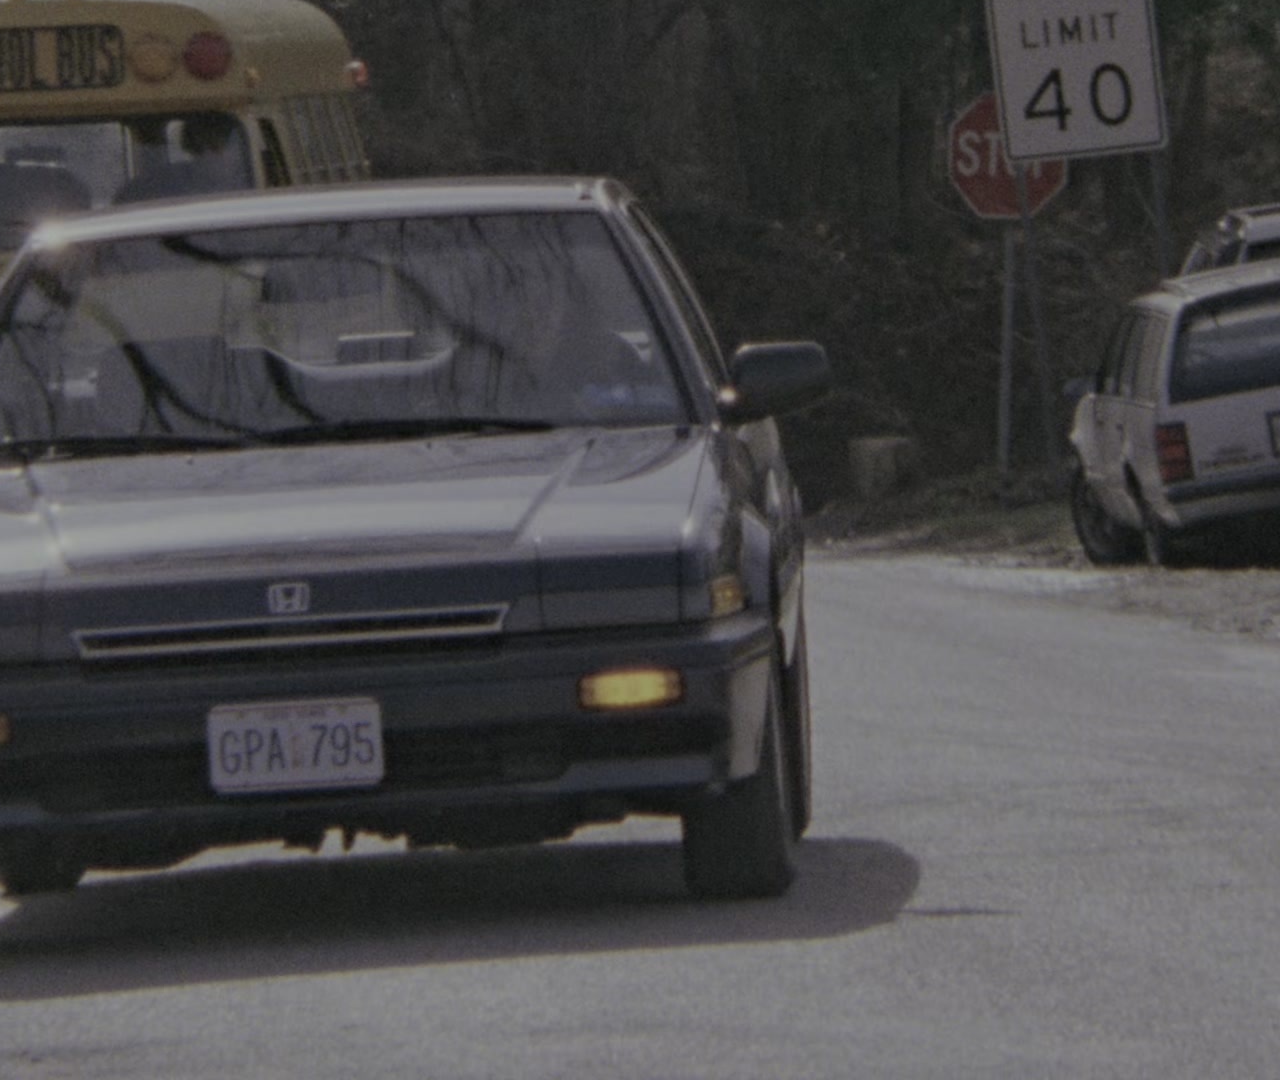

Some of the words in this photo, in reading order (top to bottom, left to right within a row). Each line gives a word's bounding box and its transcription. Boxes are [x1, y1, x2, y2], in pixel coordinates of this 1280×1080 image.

[57, 26, 122, 87] BUS
[1021, 12, 1119, 49] LIMIT
[1024, 63, 1133, 132] 40
[956, 130, 1042, 180] ST
[219, 727, 286, 775] GPA
[310, 721, 375, 768] 795
